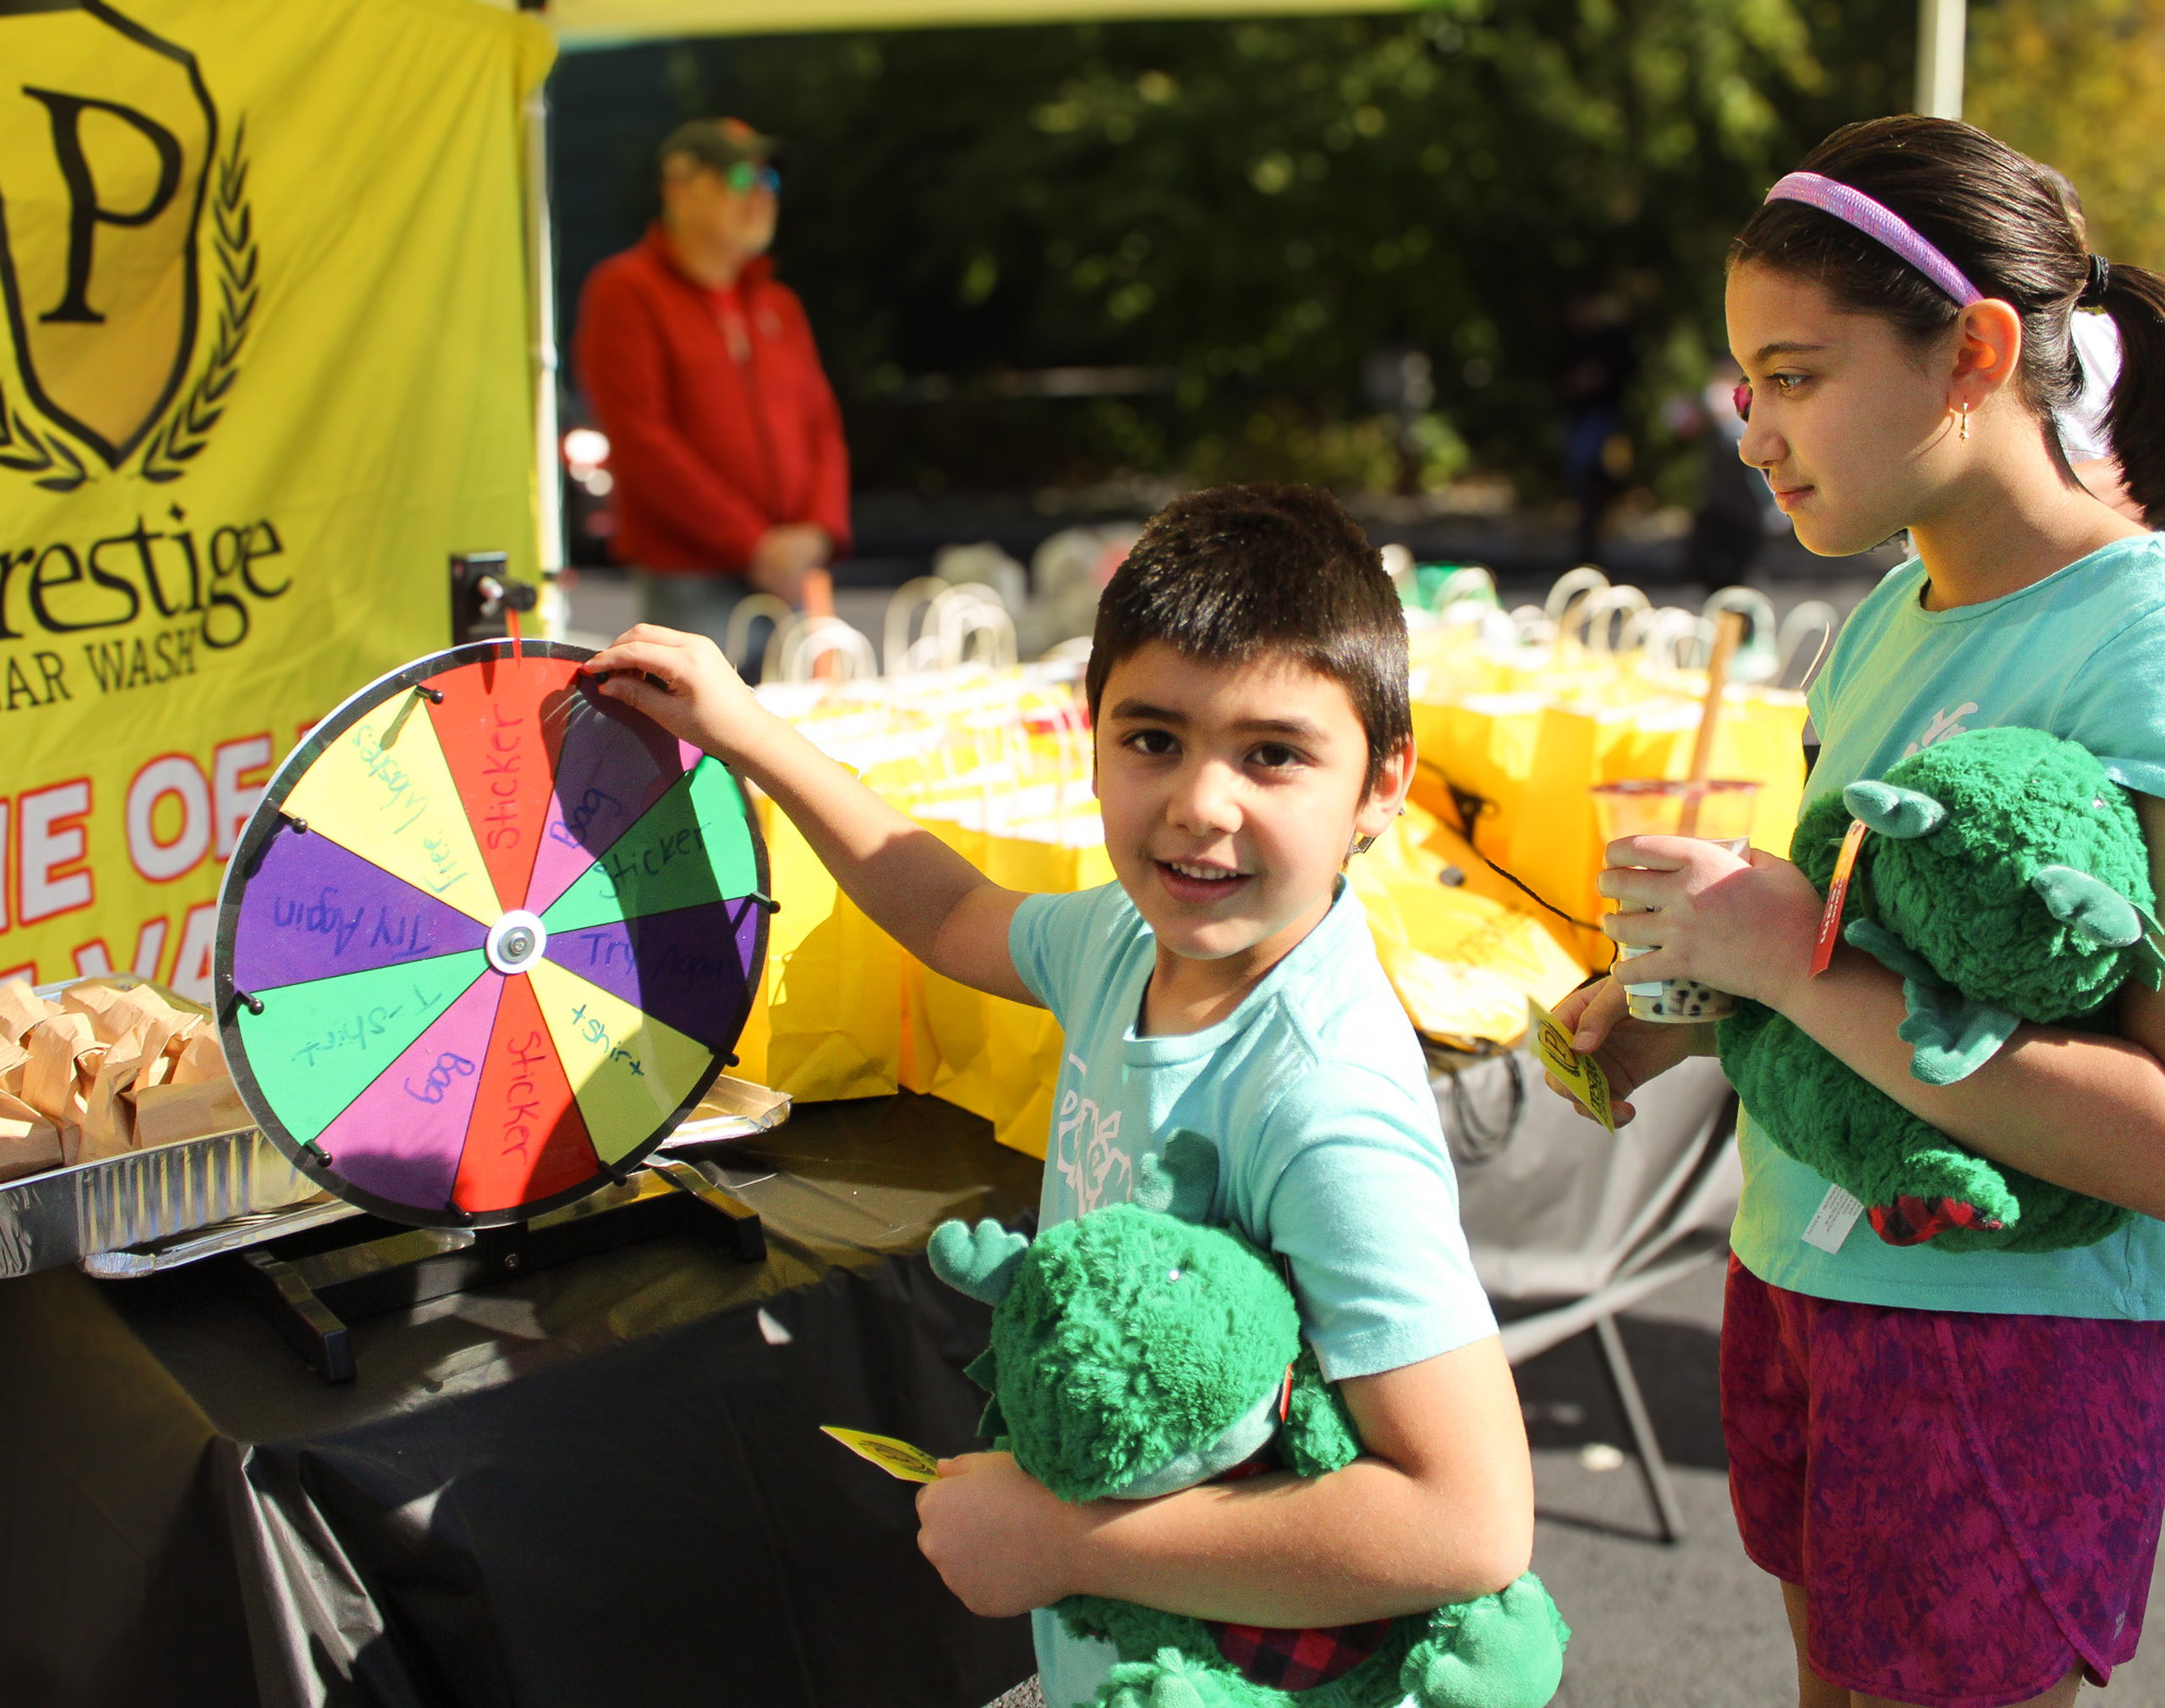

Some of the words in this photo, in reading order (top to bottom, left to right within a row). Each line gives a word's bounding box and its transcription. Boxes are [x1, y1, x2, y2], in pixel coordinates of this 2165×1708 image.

[21, 85, 183, 324] P
[0, 649, 74, 711] AR
[85, 627, 197, 695] WASH
[482, 703, 523, 850] Sticker
[551, 787, 622, 849] Bag
[273, 886, 364, 956] Again
[370, 906, 430, 959] Try
[580, 933, 644, 976] Try
[404, 1052, 475, 1105] Bag
[502, 1030, 545, 1166] Sticker
